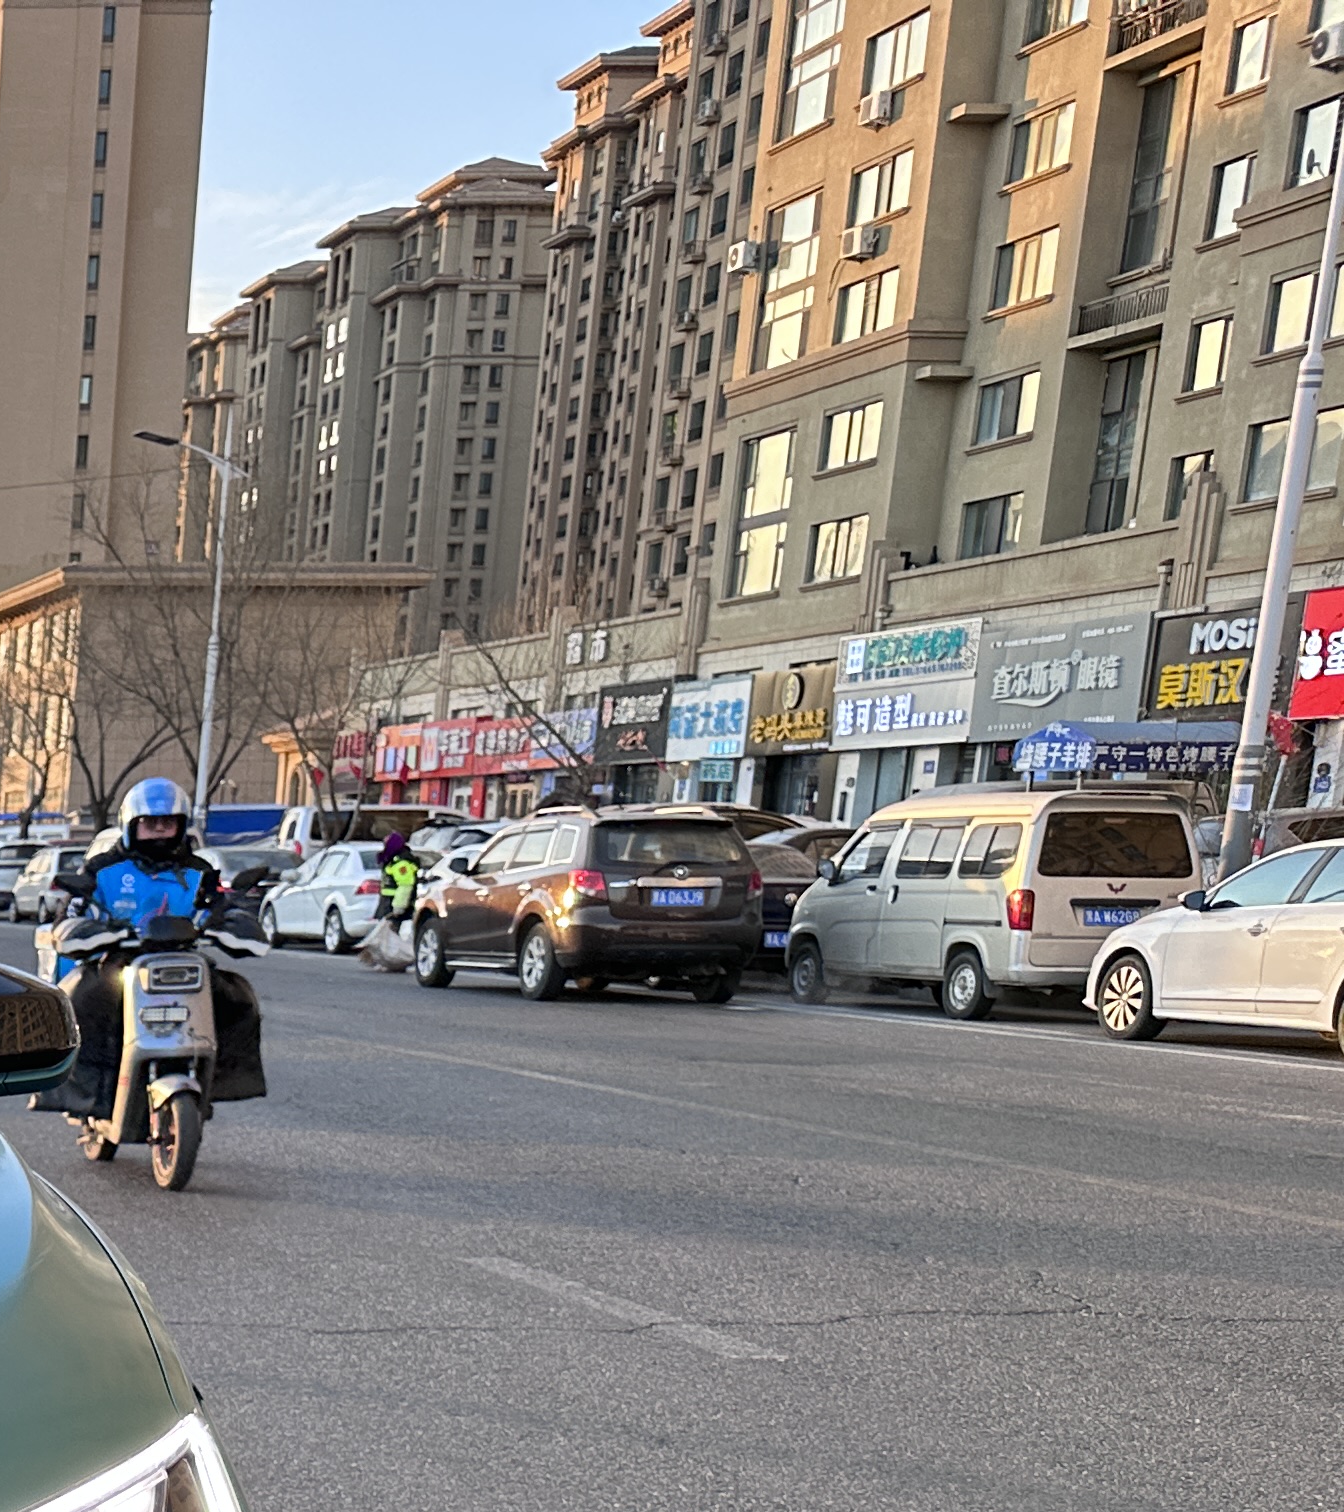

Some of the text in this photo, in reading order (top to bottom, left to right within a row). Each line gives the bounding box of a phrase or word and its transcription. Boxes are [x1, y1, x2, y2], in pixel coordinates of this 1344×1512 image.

[565, 628, 608, 666] 超市
[1156, 657, 1252, 710] 莫斯汉
